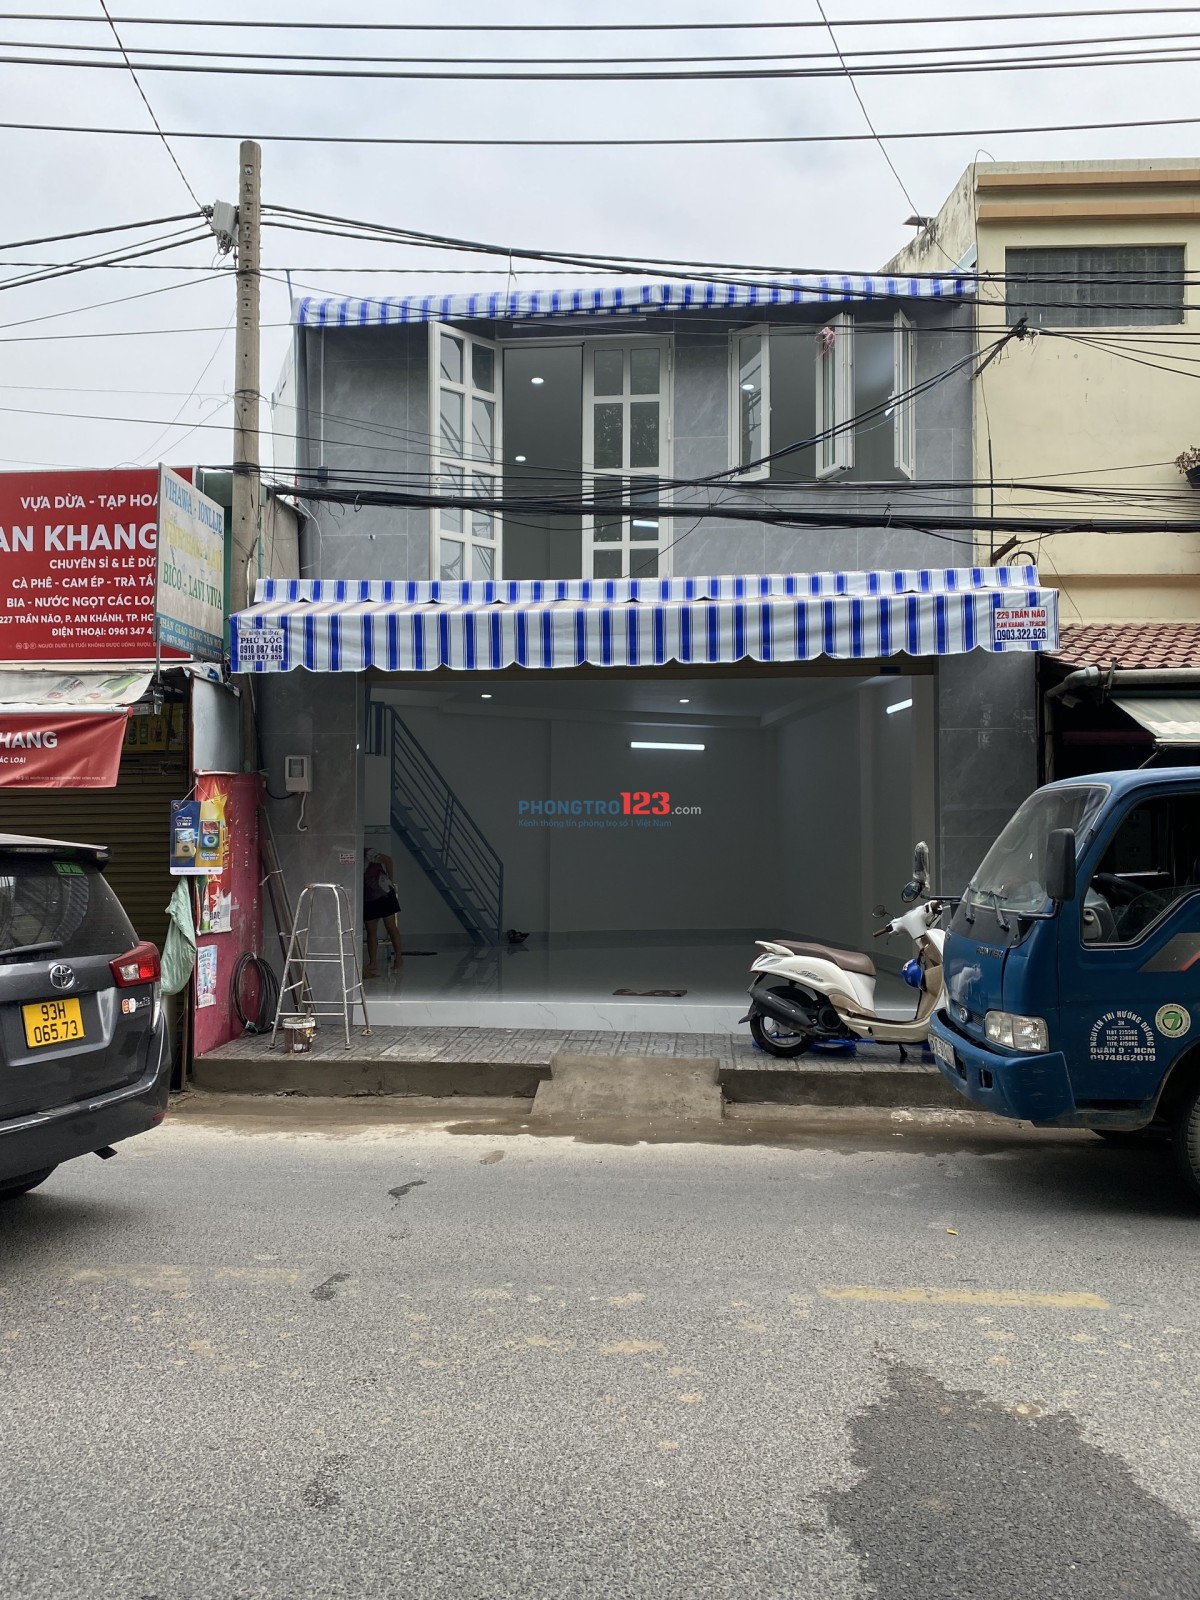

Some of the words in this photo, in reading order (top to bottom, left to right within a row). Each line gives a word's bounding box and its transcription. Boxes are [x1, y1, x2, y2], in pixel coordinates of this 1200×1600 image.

[20, 496, 50, 511] VỰA
[55, 493, 86, 508] DỪA
[98, 495, 126, 510] TẠP
[0, 526, 33, 552] AN
[45, 523, 157, 551] KHANG
[50, 557, 96, 569] CHUYÊN
[112, 559, 119, 568] &
[12, 576, 28, 588] CÀ
[31, 576, 52, 588] PHÊ
[62, 578, 88, 588] CAM
[91, 575, 104, 587] ÉP
[114, 575, 136, 587] TRÀ
[139, 573, 156, 587] TẮ
[162, 560, 182, 591] BICO
[188, 573, 204, 602] LAVI
[206, 582, 222, 610] VIVA
[6, 598, 25, 608] BIA
[35, 595, 69, 607] NƯỚC
[72, 597, 105, 608] NGỌT
[108, 594, 132, 606] CÁC
[90, 613, 124, 624] KHÁNH,
[997, 611, 1009, 619] 229
[52, 626, 73, 637] ĐIỆN
[75, 628, 106, 636] THOẠI:
[997, 628, 1046, 640] 0903.322.926
[264, 636, 282, 644] LỘC
[42, 1002, 66, 1022] 93H
[34, 1020, 78, 1043] 065.73
